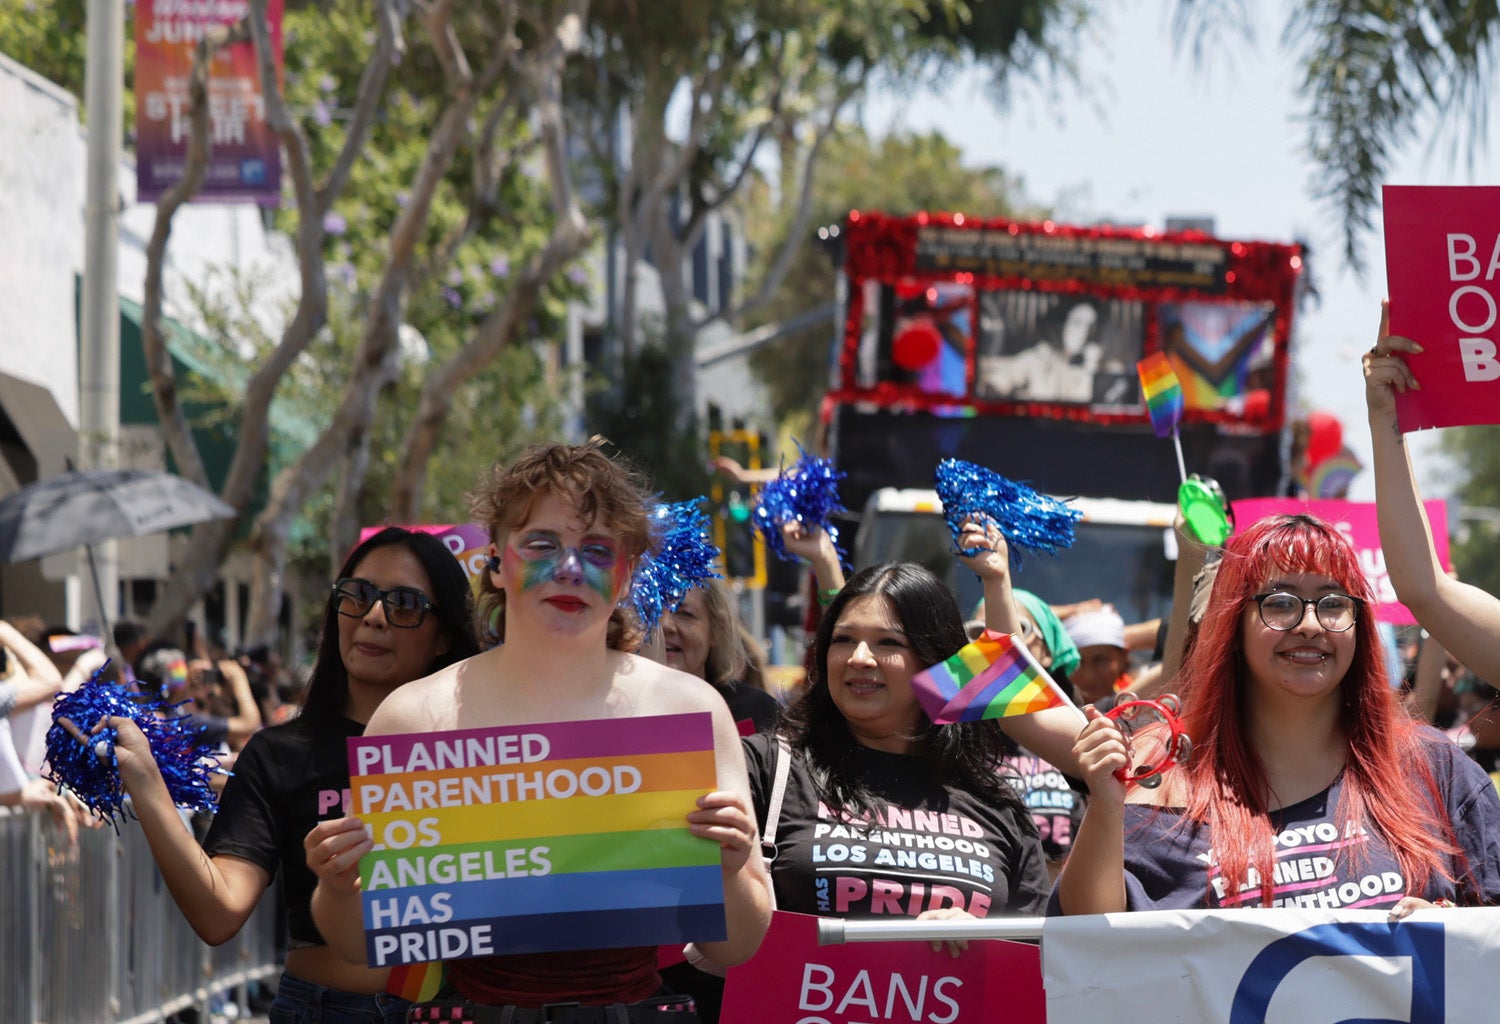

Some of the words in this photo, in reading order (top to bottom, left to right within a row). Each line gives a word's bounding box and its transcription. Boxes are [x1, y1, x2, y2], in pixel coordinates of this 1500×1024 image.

[145, 92, 266, 121] STEET
[171, 117, 245, 145] FIR
[356, 733, 551, 777] PLANNED
[360, 765, 642, 815] PARENTHOOD
[1025, 790, 1074, 809] ELES
[364, 817, 441, 851] LOS
[813, 823, 991, 859] PARENTHOOD
[1271, 822, 1339, 847] OYO
[367, 846, 552, 891] ANGELES
[812, 843, 867, 864] LOS
[873, 848, 995, 884] ANGELES
[1210, 856, 1336, 899] PANED
[815, 877, 831, 912] HAS
[835, 876, 993, 919] PRIDE
[1242, 871, 1404, 909] ENTHOOD
[371, 892, 454, 930] HAS
[374, 925, 495, 967] PRIDE
[798, 962, 964, 1024] BANS
